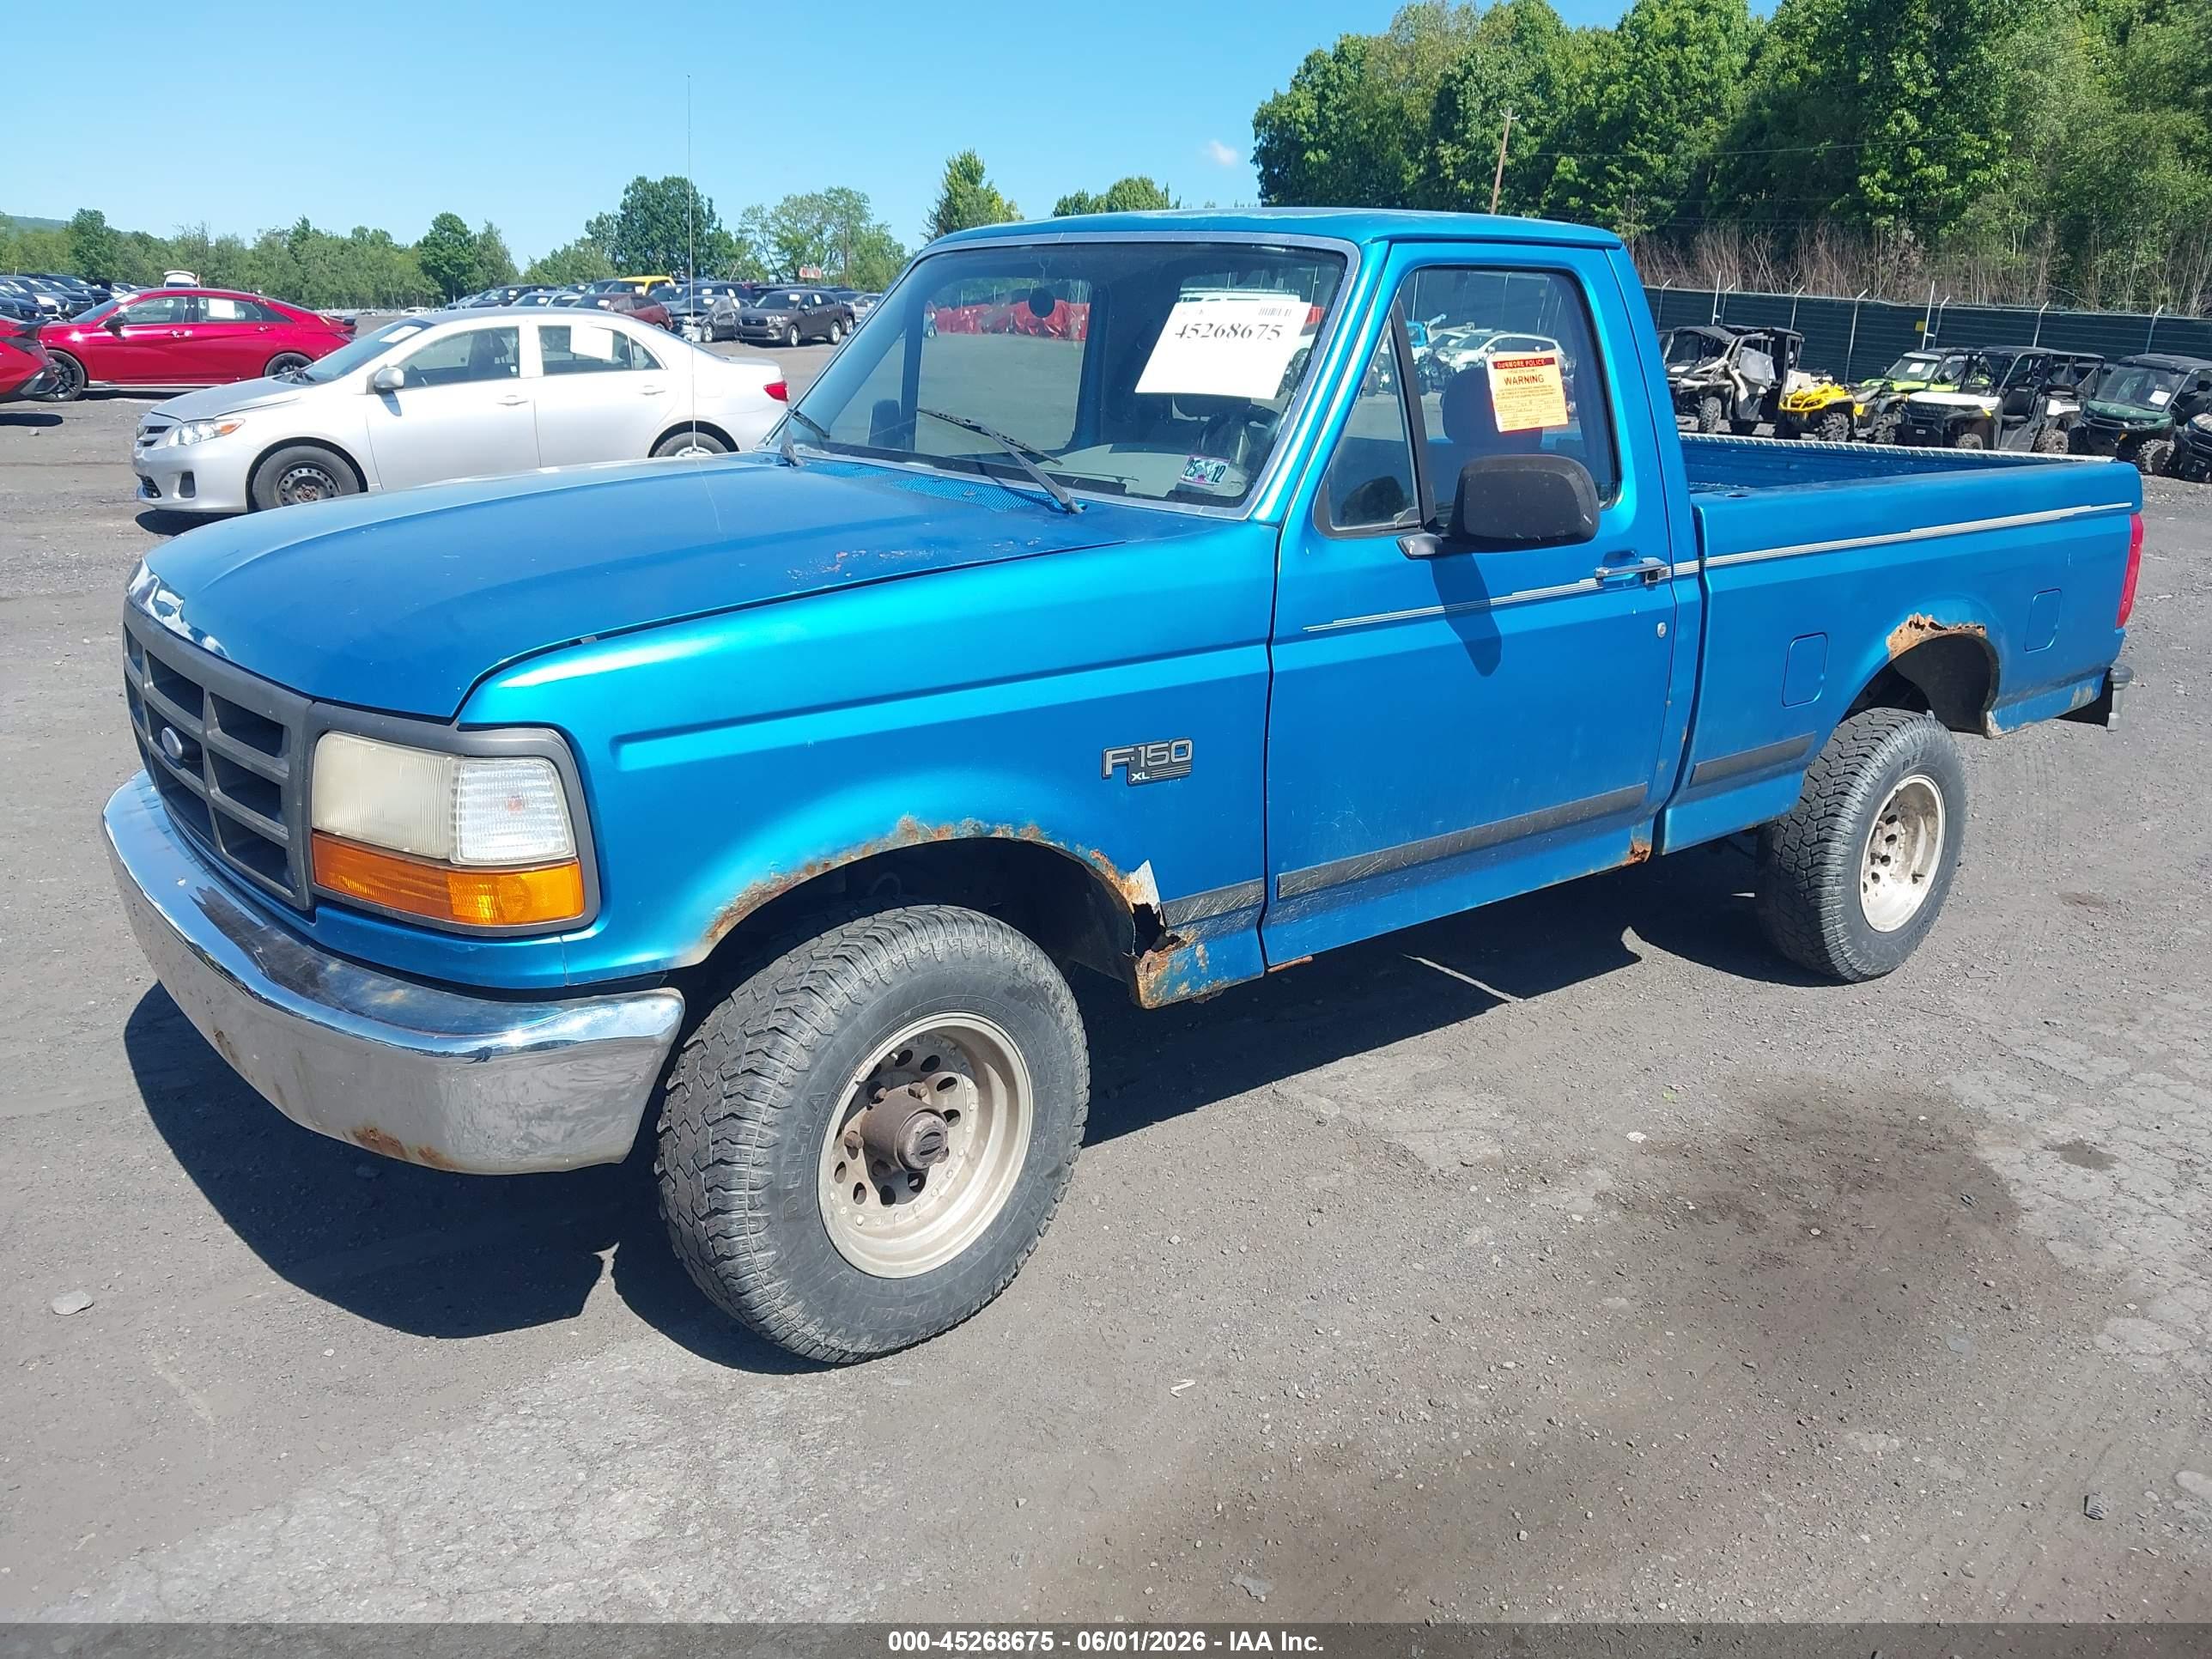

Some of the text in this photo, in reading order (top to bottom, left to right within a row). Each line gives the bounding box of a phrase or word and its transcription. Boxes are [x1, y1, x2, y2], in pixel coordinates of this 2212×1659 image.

[1175, 323, 1284, 341] 45268675
[1504, 374, 1545, 386] WARNING
[1211, 465, 1226, 483] 12
[1131, 772, 1151, 781] XL
[782, 1092, 828, 1223] DELTA
